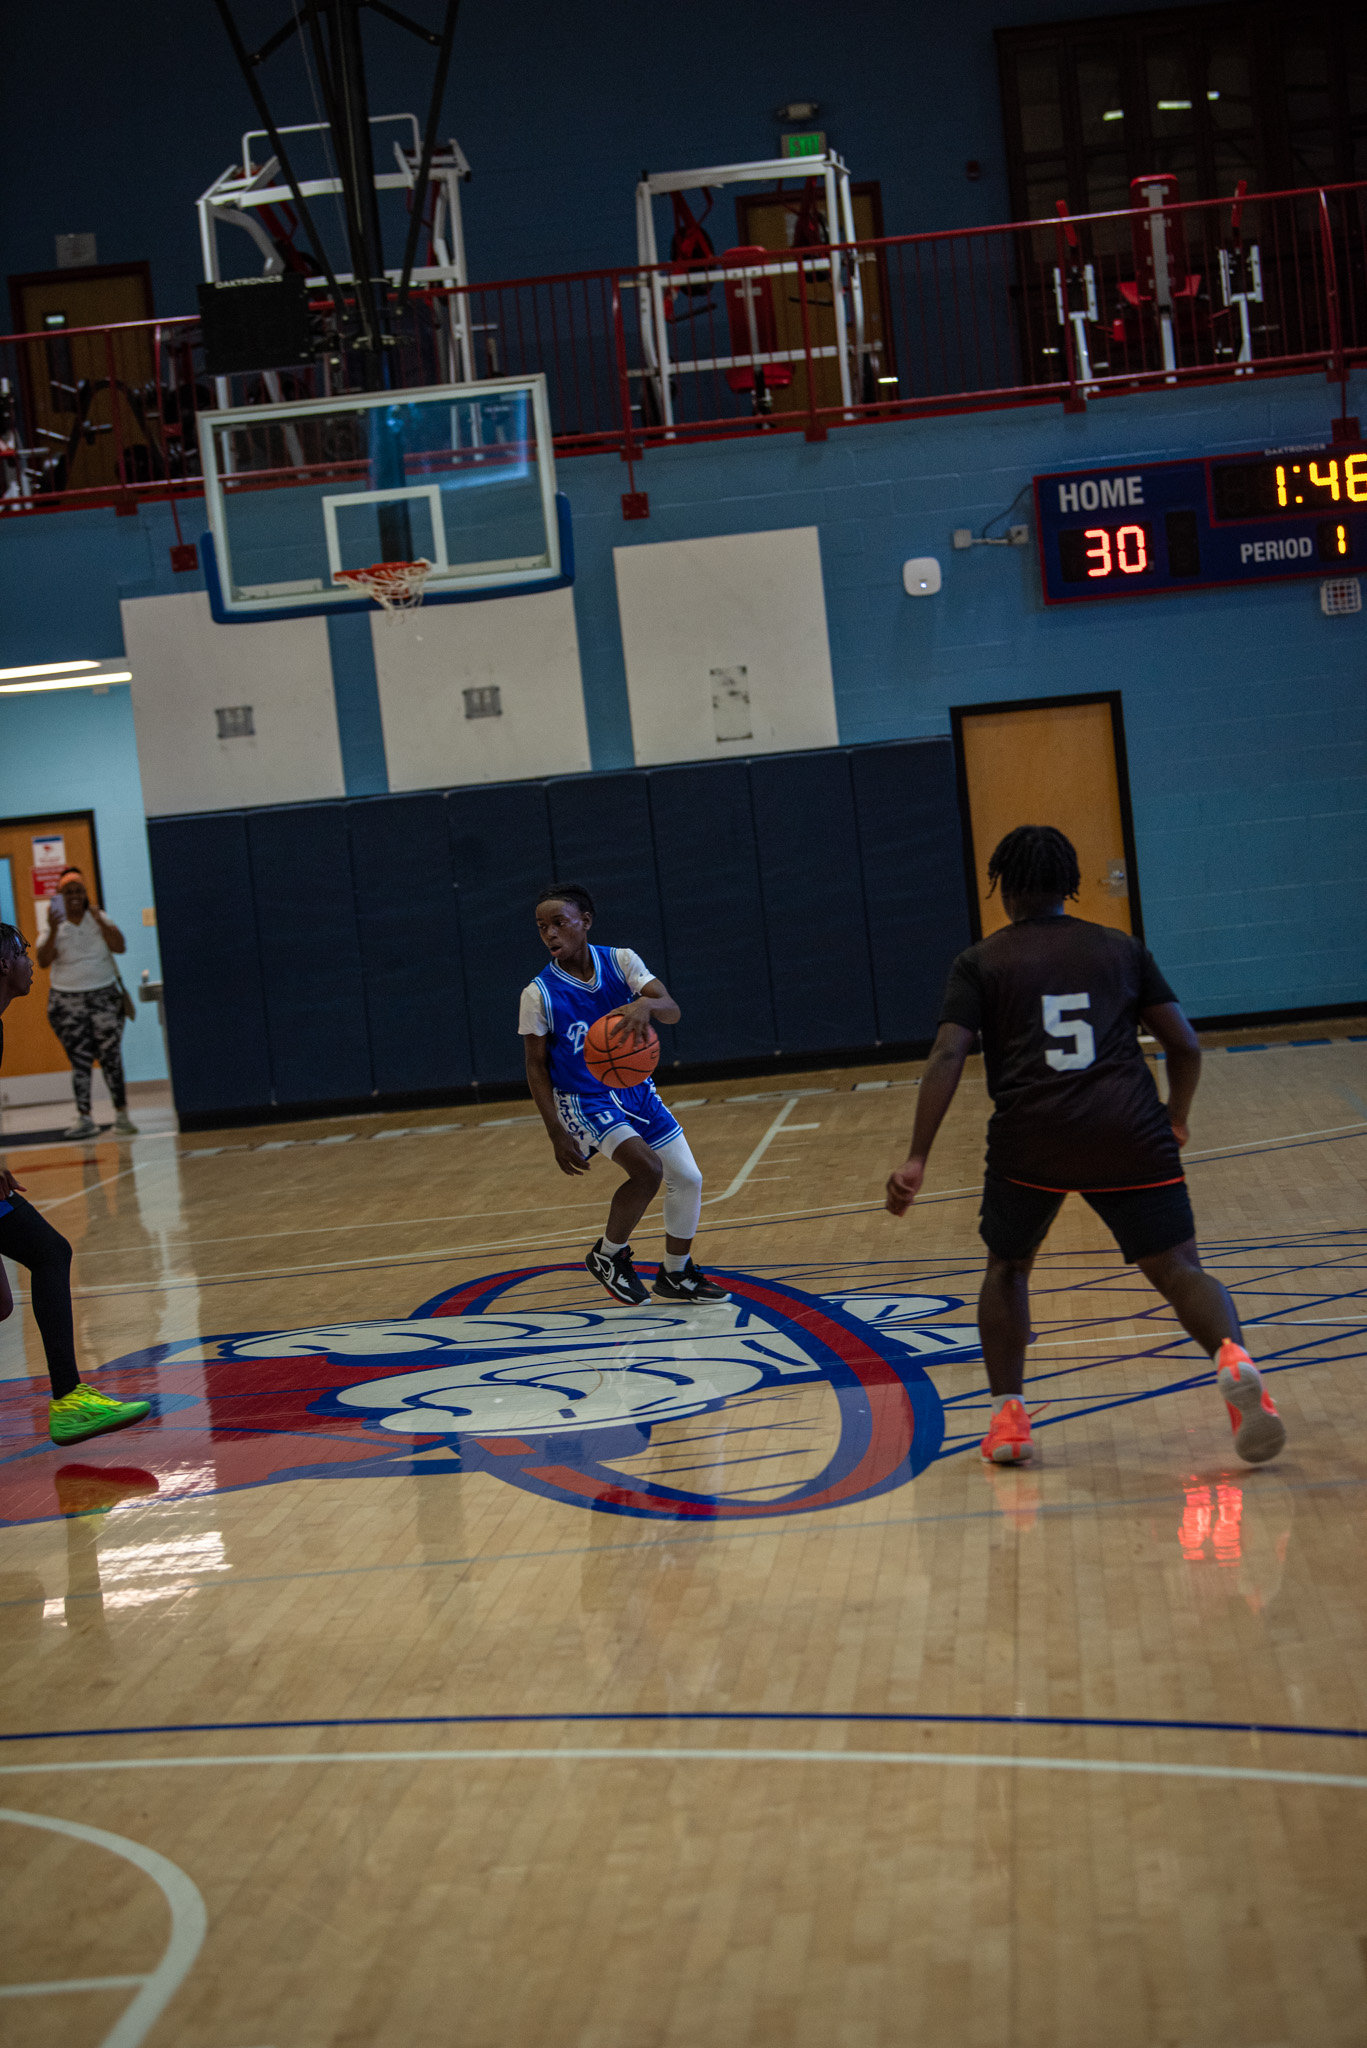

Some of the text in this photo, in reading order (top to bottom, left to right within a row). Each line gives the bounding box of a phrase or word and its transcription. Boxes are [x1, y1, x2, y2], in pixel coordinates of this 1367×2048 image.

[1058, 475, 1145, 513] HOME
[1084, 525, 1147, 577] 30
[1240, 536, 1313, 564] PERIOD
[1336, 524, 1347, 555] 1
[1041, 992, 1096, 1072] 5
[595, 1110, 615, 1125] U
